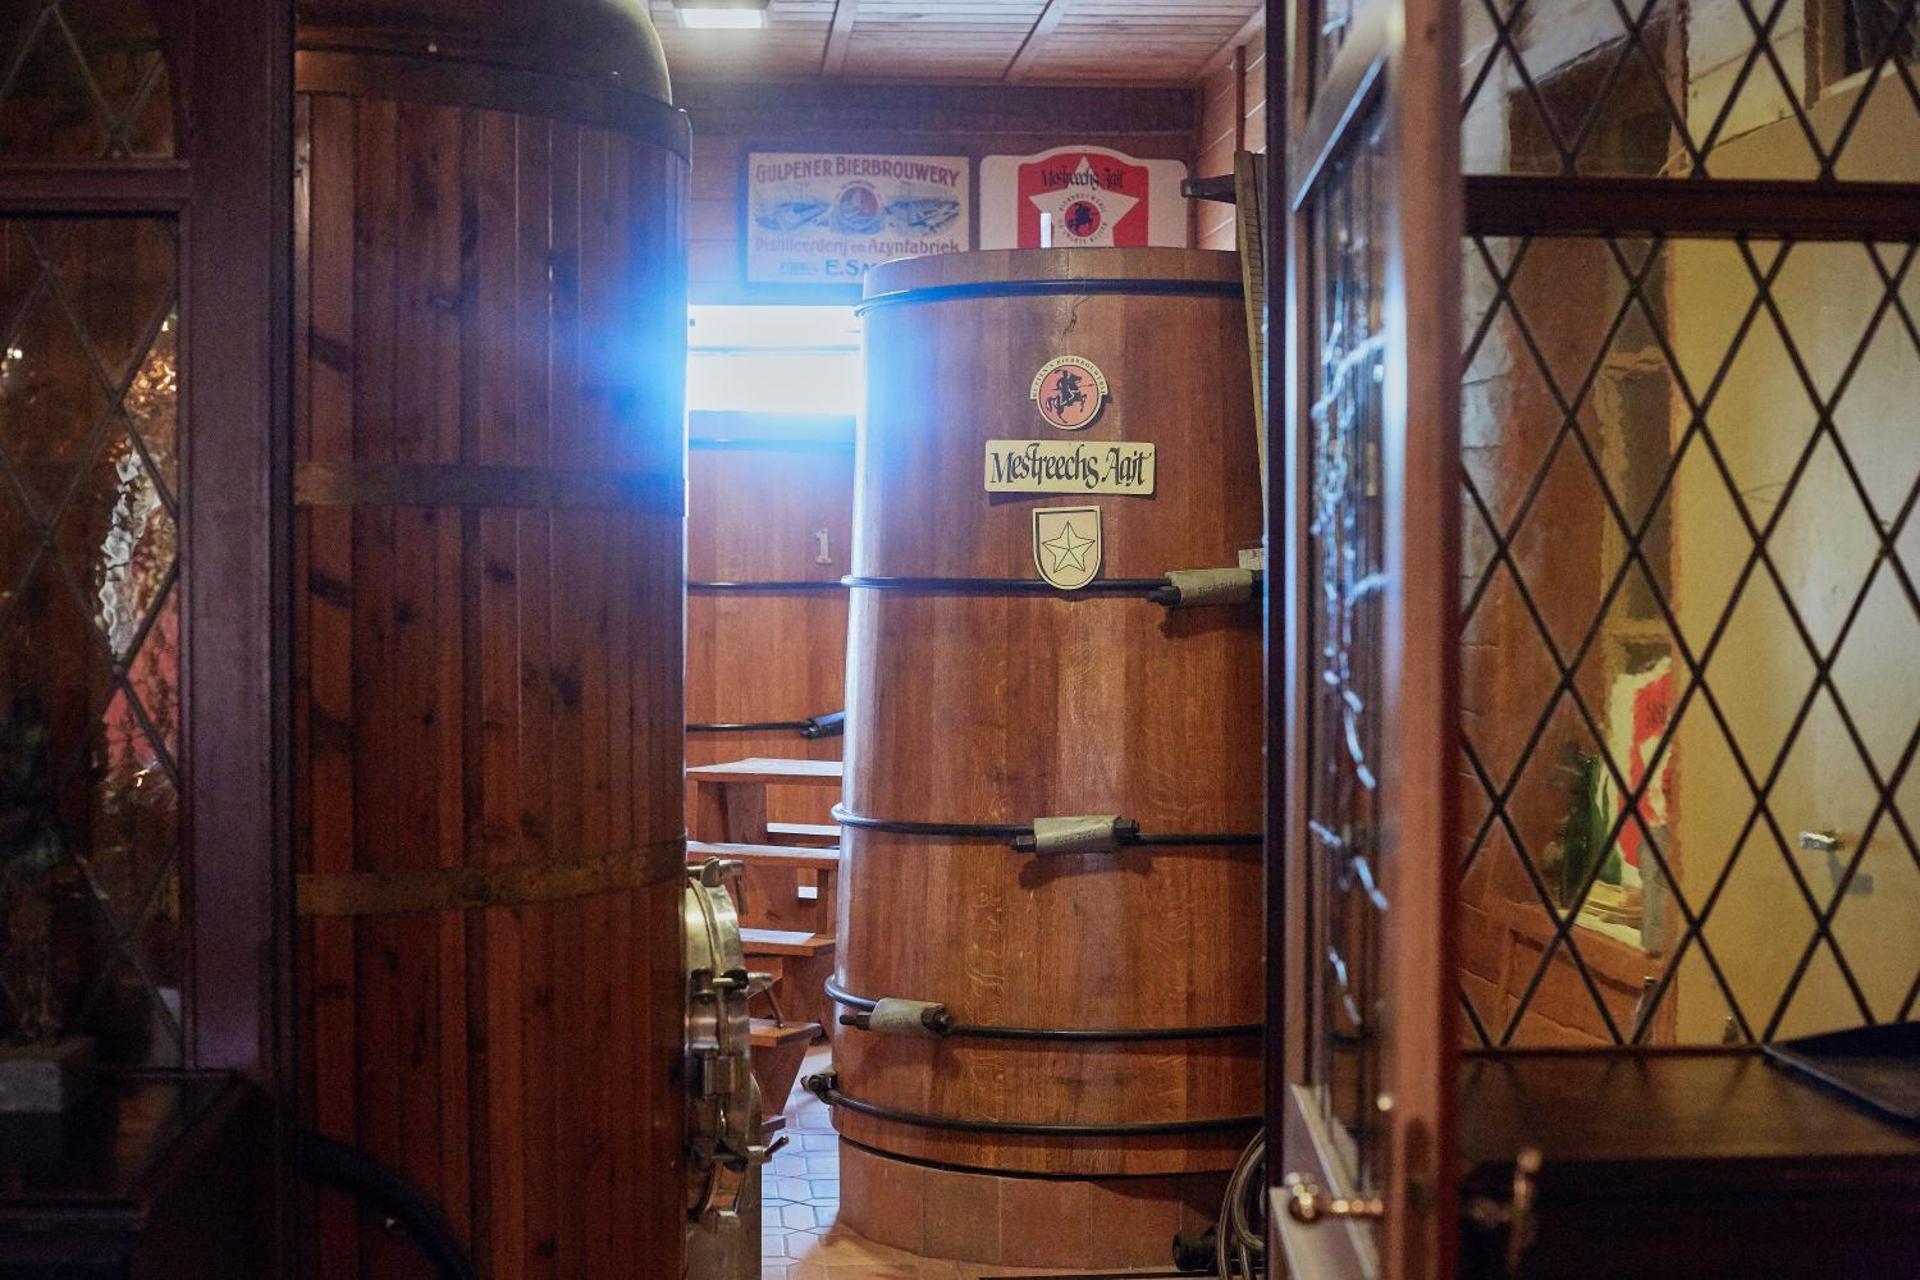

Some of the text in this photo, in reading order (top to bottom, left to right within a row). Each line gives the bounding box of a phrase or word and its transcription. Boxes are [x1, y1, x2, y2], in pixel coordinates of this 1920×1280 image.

[756, 156, 960, 187] GULPENER BIERBROUWERY
[990, 443, 1099, 489] Mestreechs
[816, 528, 832, 563] 1
